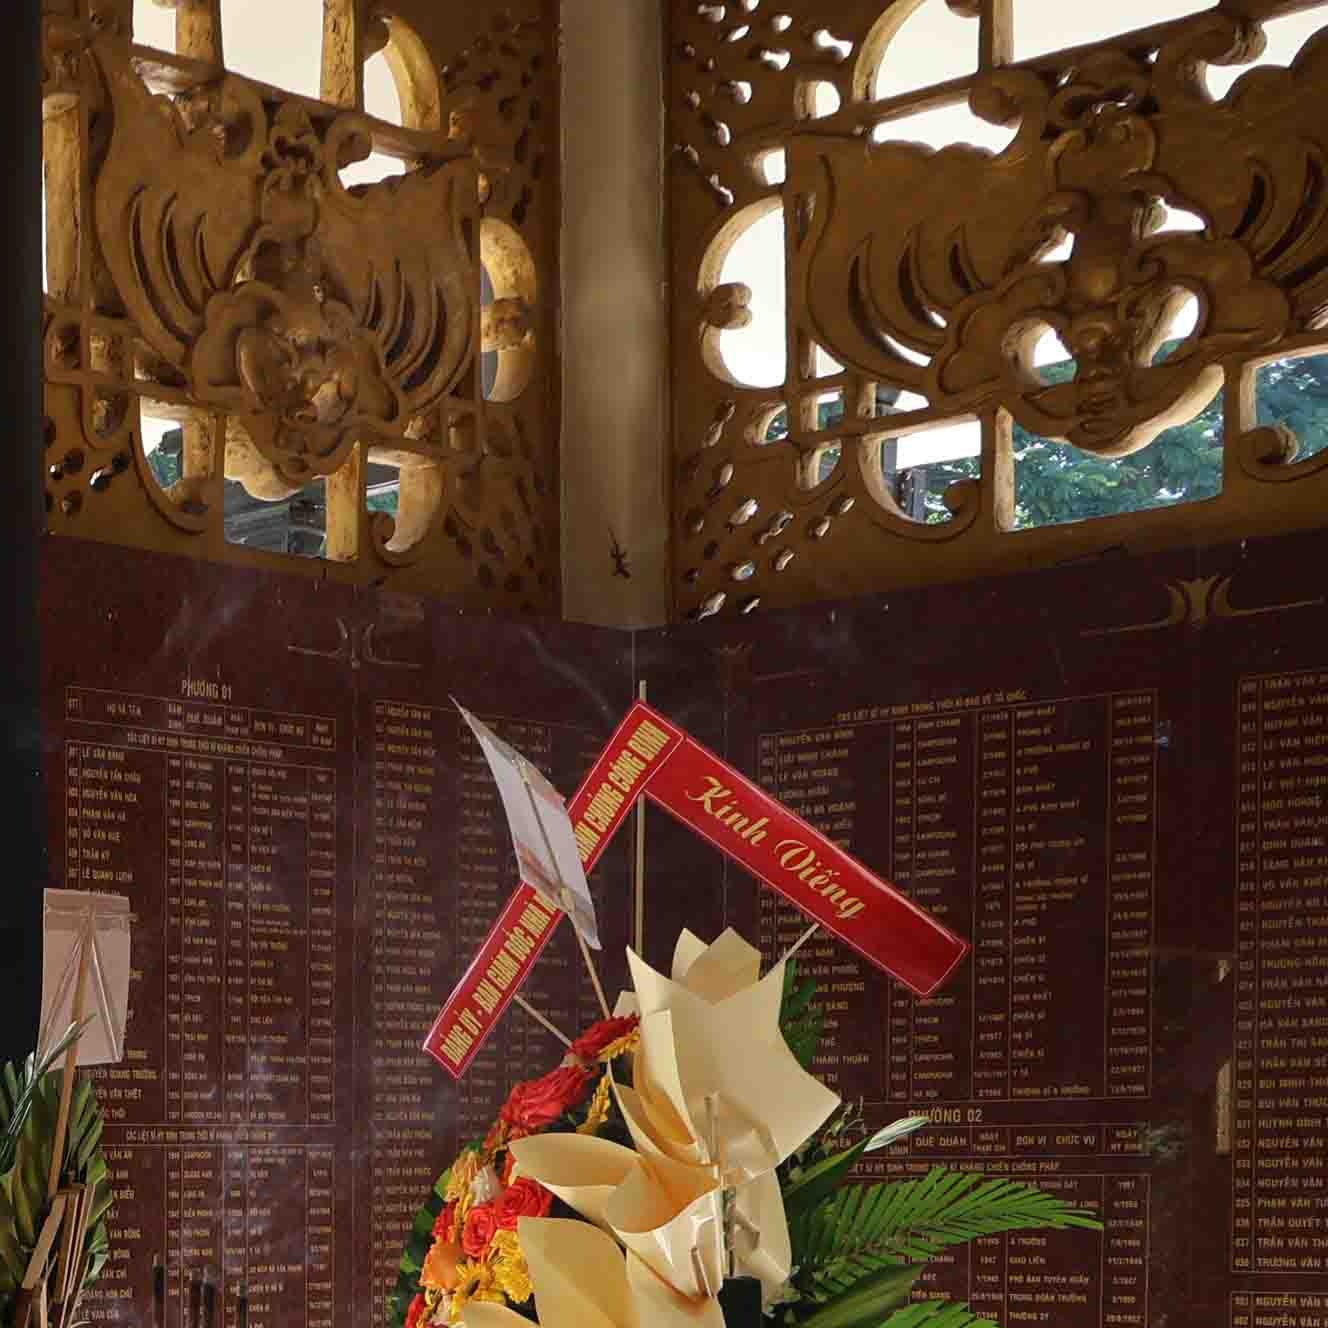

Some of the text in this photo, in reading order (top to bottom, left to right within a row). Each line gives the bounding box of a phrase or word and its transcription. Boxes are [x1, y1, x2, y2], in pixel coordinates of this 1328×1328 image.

[687, 776, 769, 846] Kính
[774, 839, 865, 919] Viếng
[967, 1109, 983, 1122] 02
